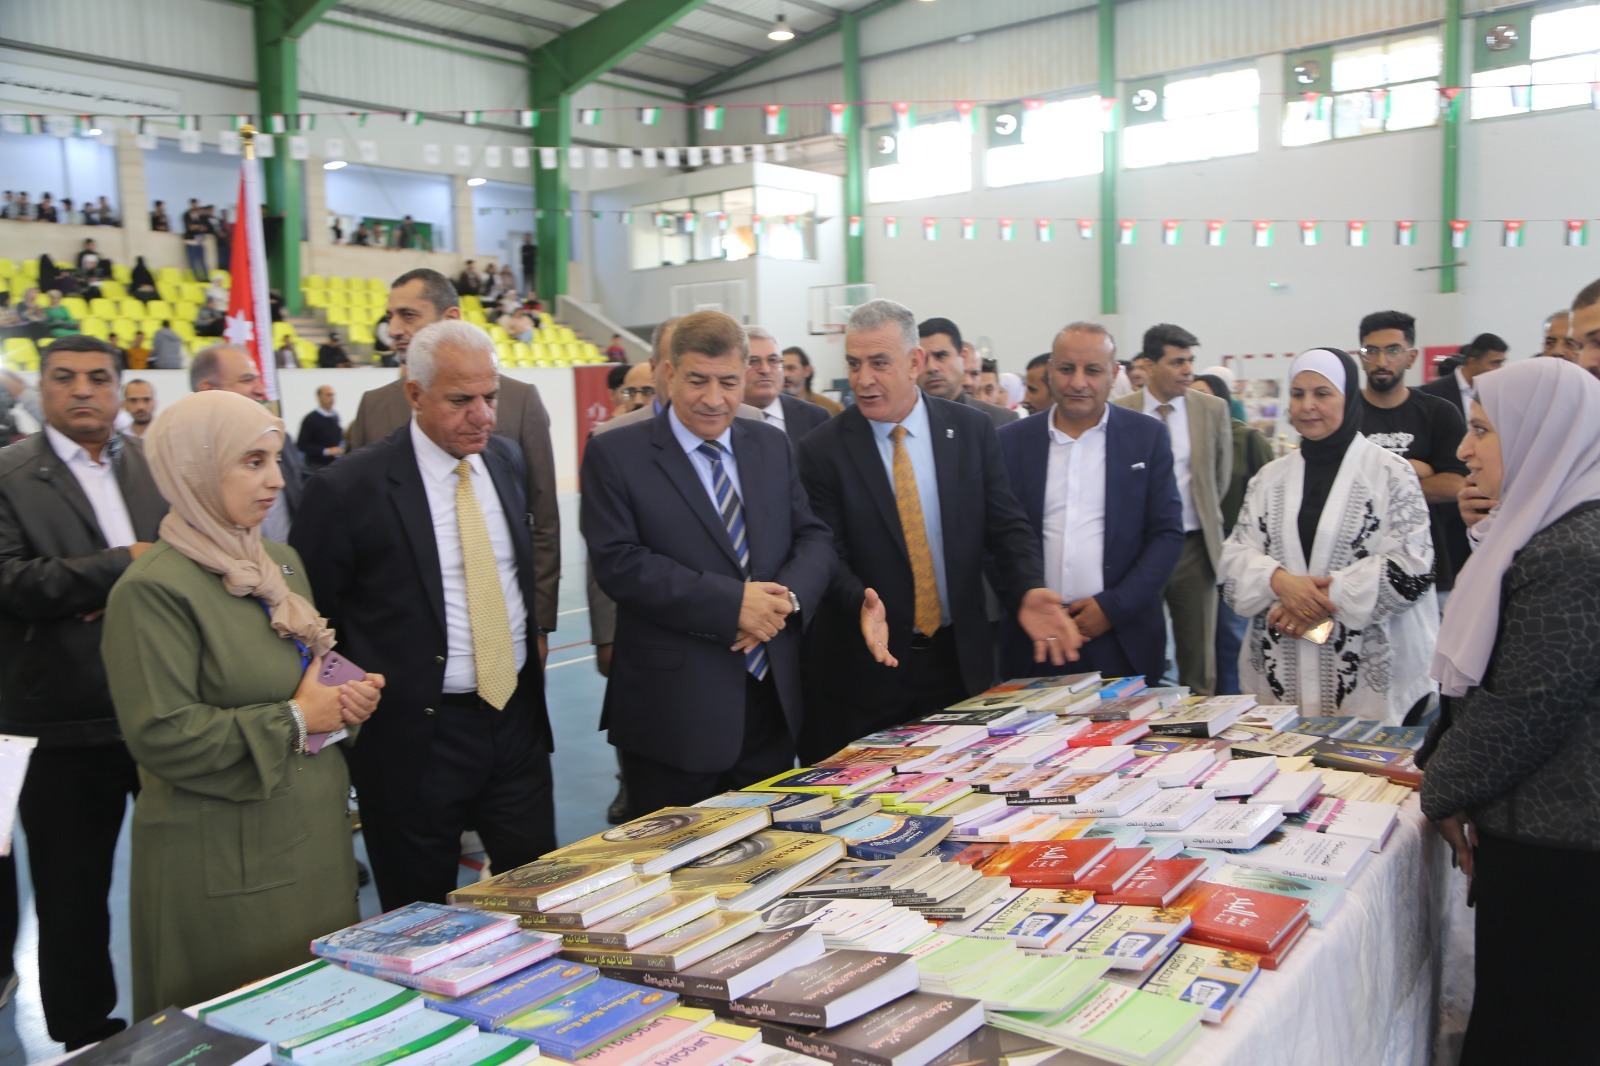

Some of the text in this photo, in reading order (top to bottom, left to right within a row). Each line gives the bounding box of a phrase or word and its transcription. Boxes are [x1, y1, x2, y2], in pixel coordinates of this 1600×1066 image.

[1282, 870, 1307, 878] السلوك
[497, 898, 508, 906] قضايا
[533, 915, 547, 924] قضايا
[574, 934, 589, 944] قضايا
[598, 955, 606, 965] كل
[606, 955, 616, 966] تهم
[616, 955, 633, 966] قضايا
[476, 964, 567, 1006] صحة البيئة وسلامتها
[555, 989, 646, 1035] صحة البيئة وسلامتها
